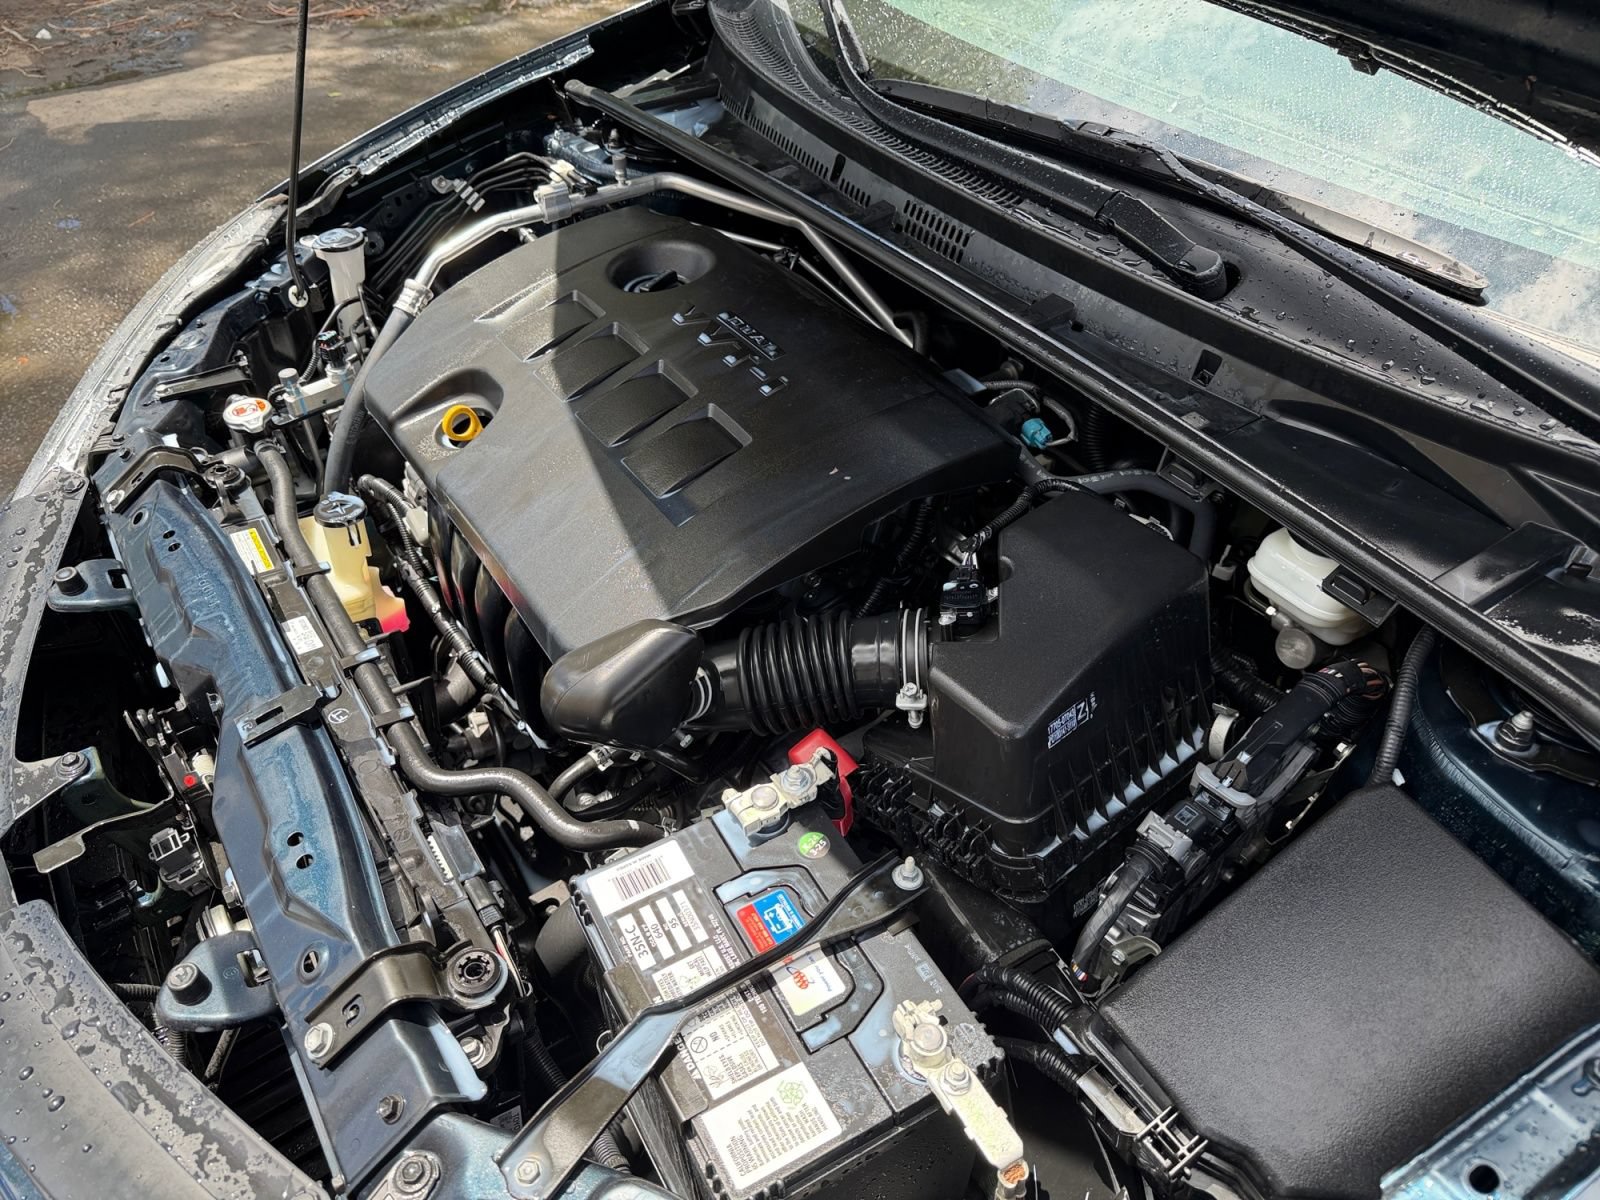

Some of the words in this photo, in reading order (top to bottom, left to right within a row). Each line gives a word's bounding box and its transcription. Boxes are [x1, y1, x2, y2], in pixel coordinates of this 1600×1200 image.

[649, 922, 664, 939] 640
[667, 916, 679, 929] 95
[623, 923, 650, 959] 35N-C
[670, 1032, 697, 1071] DANGE
[708, 1030, 720, 1042] NO
[724, 1142, 747, 1177] CALIFORNIA
[728, 1134, 753, 1174] PROPOSITION
[735, 1133, 755, 1164] WARNING
